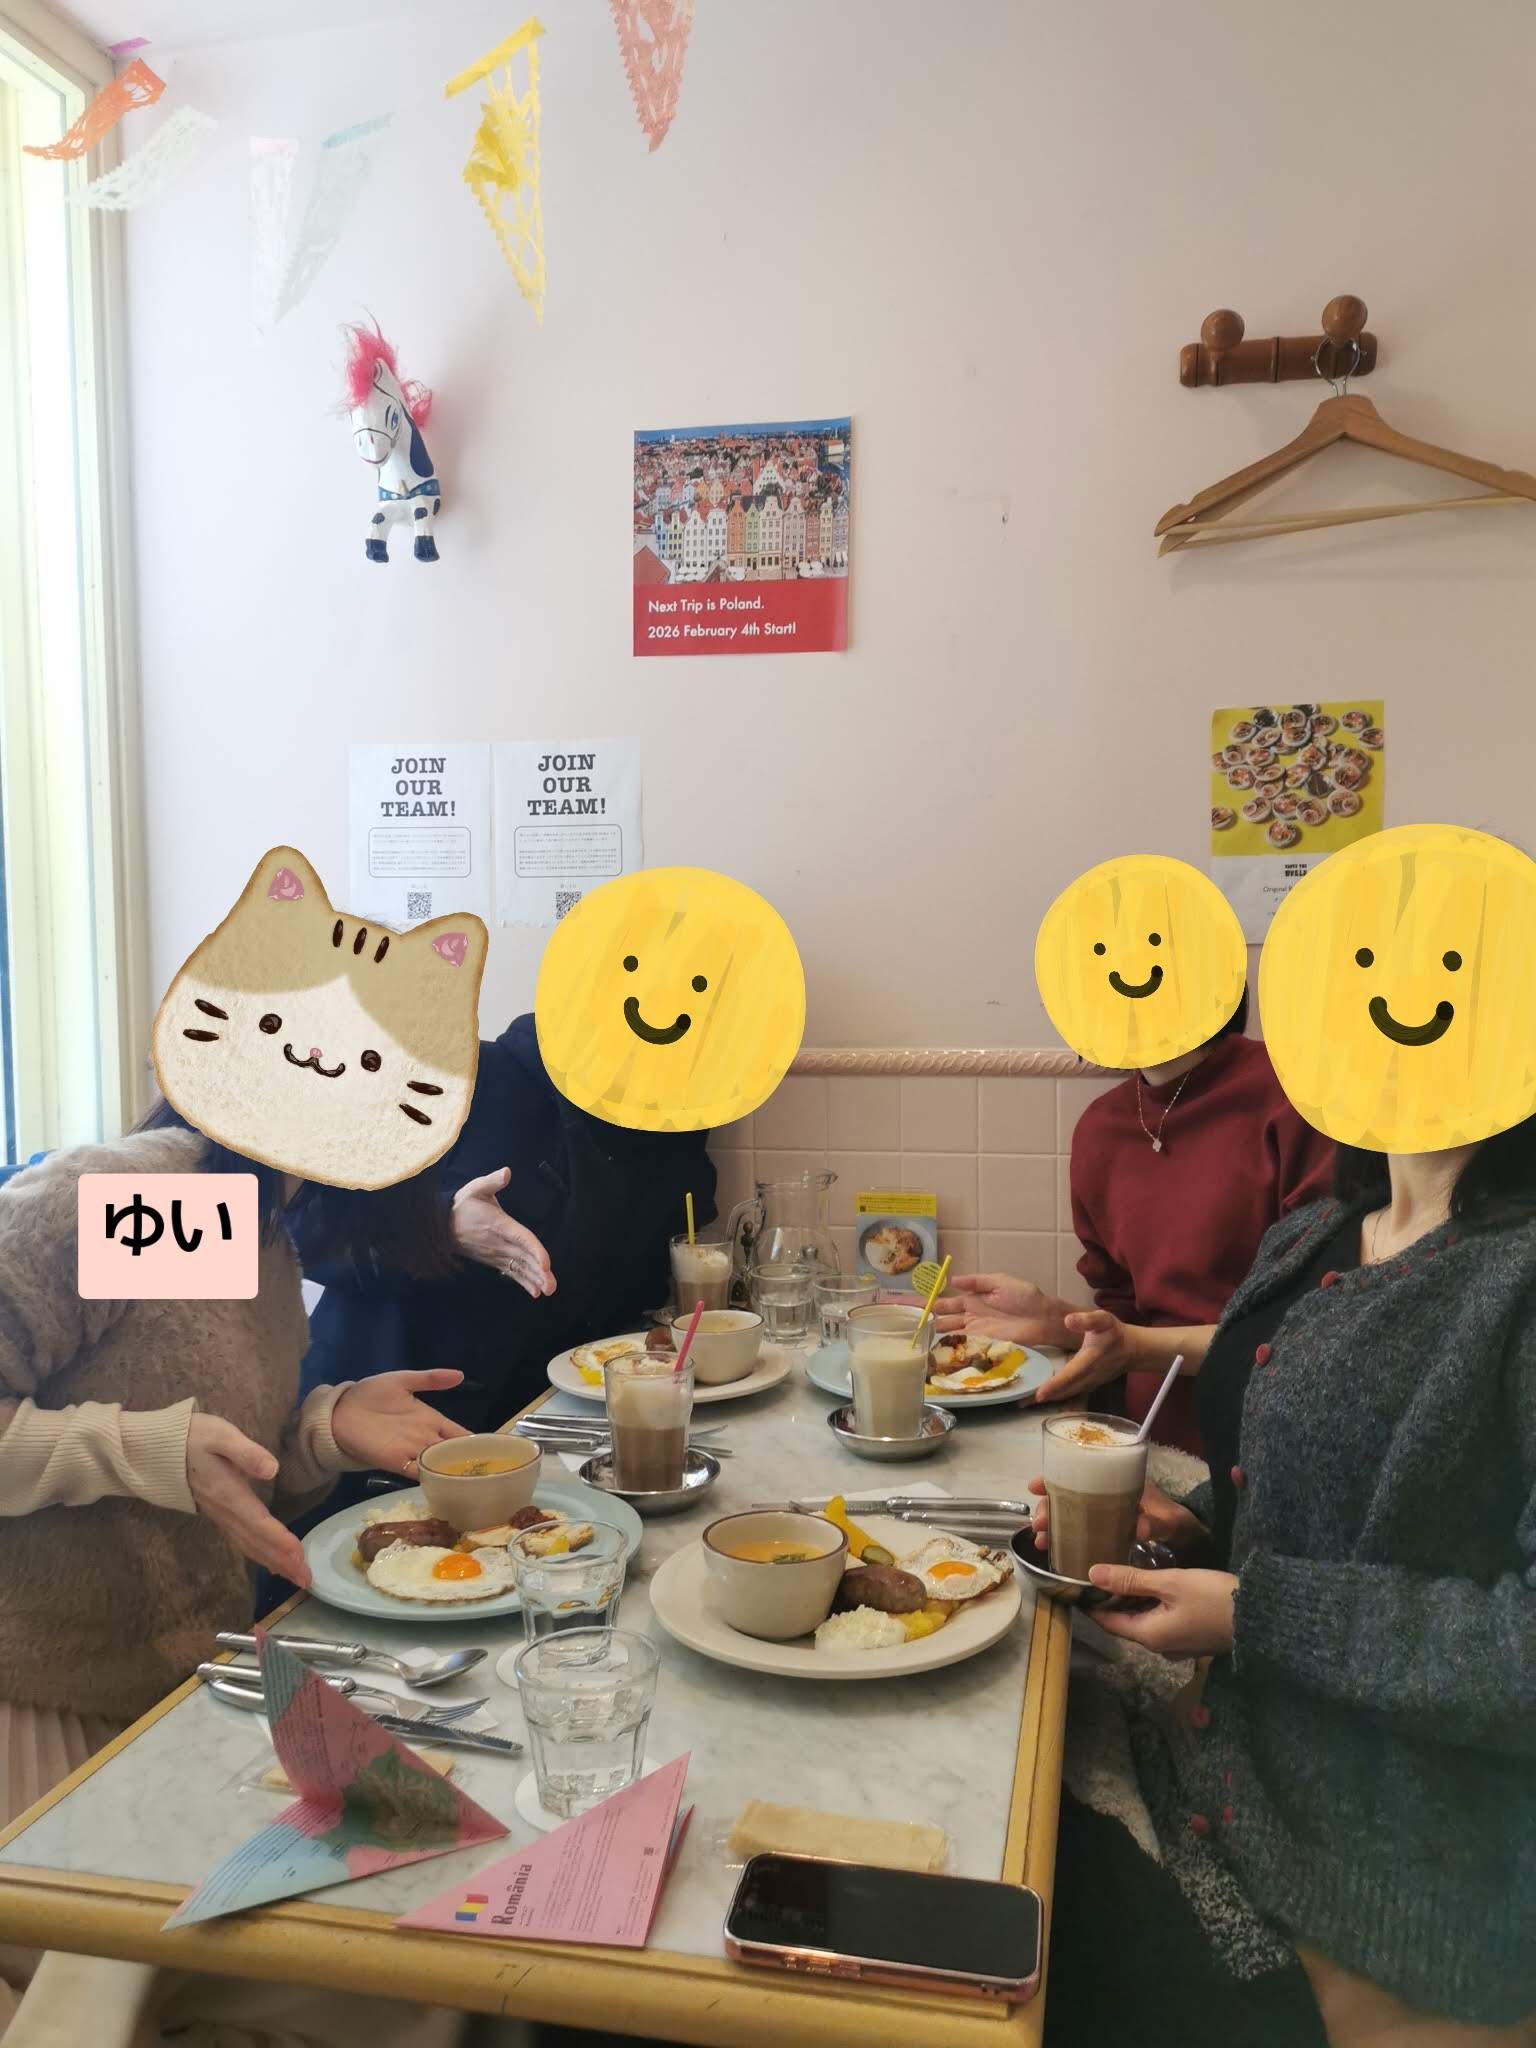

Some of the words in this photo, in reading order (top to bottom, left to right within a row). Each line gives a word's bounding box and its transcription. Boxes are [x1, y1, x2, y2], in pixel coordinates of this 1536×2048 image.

[648, 601, 677, 613] Next
[680, 599, 703, 614] Trip
[707, 598, 716, 611] is
[719, 596, 765, 610] Poland.
[648, 625, 680, 638] 2026
[683, 624, 737, 639] February
[740, 622, 760, 635] 4th
[764, 621, 796, 634] Start!
[391, 758, 446, 774] JOIN
[538, 754, 596, 772] JOIN
[395, 780, 443, 796] OUR
[543, 777, 592, 793] OUR
[381, 801, 456, 817] TEAM!
[527, 798, 606, 815] TEAM!
[491, 1864, 532, 1925] România
